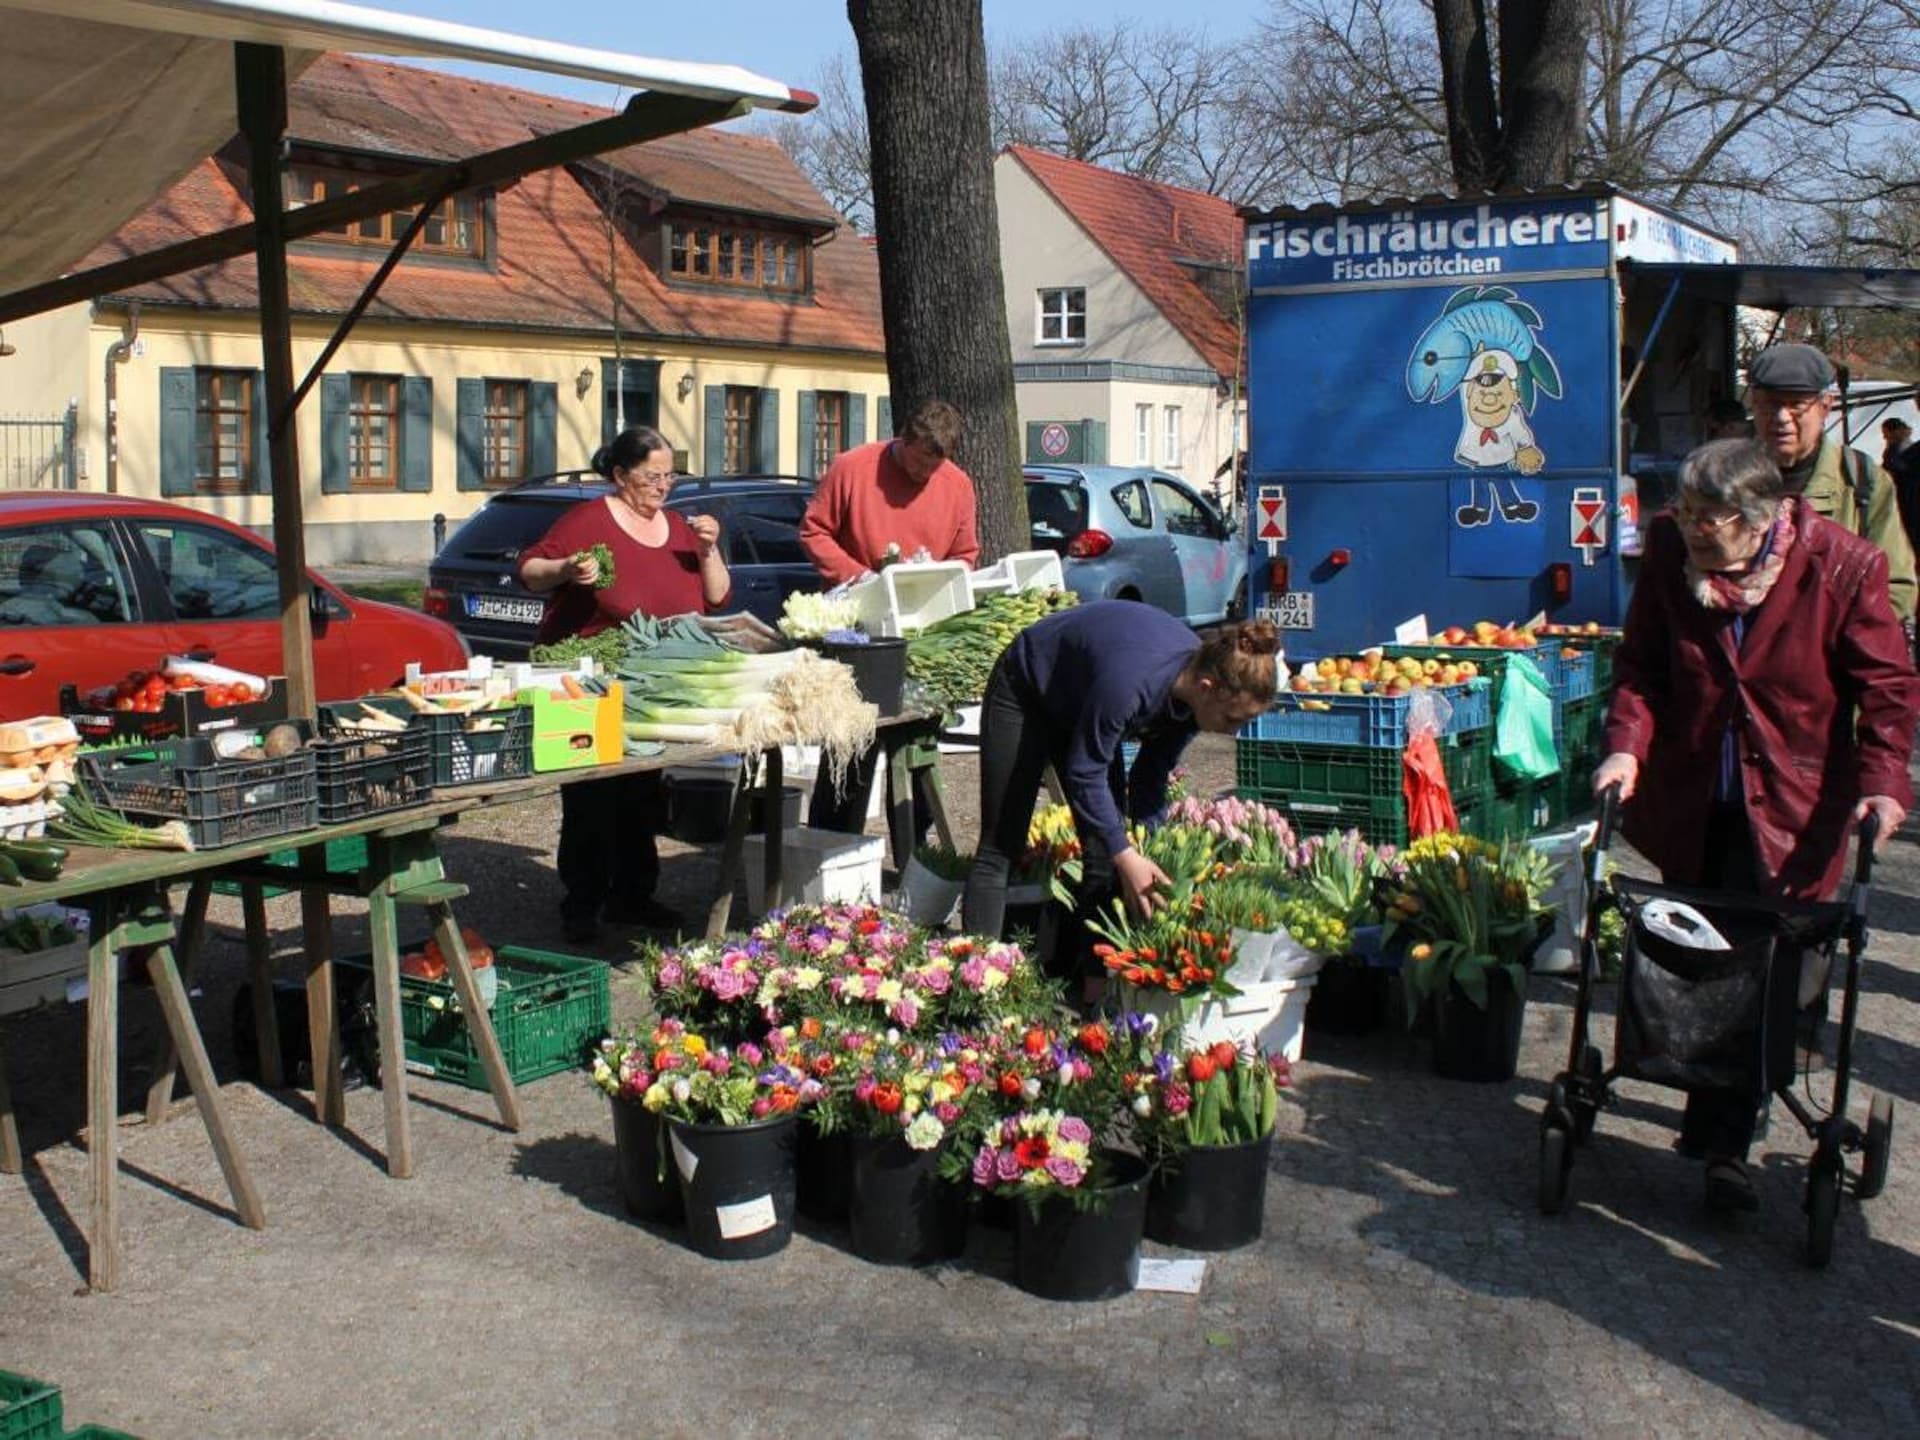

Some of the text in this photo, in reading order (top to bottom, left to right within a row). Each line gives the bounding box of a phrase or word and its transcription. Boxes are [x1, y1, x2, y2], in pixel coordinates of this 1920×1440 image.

[1248, 201, 1608, 259] Fischräucherei
[1333, 252, 1501, 280] Fischbrötchen
[1268, 593, 1297, 609] BRB
[1283, 610, 1309, 626] 241
